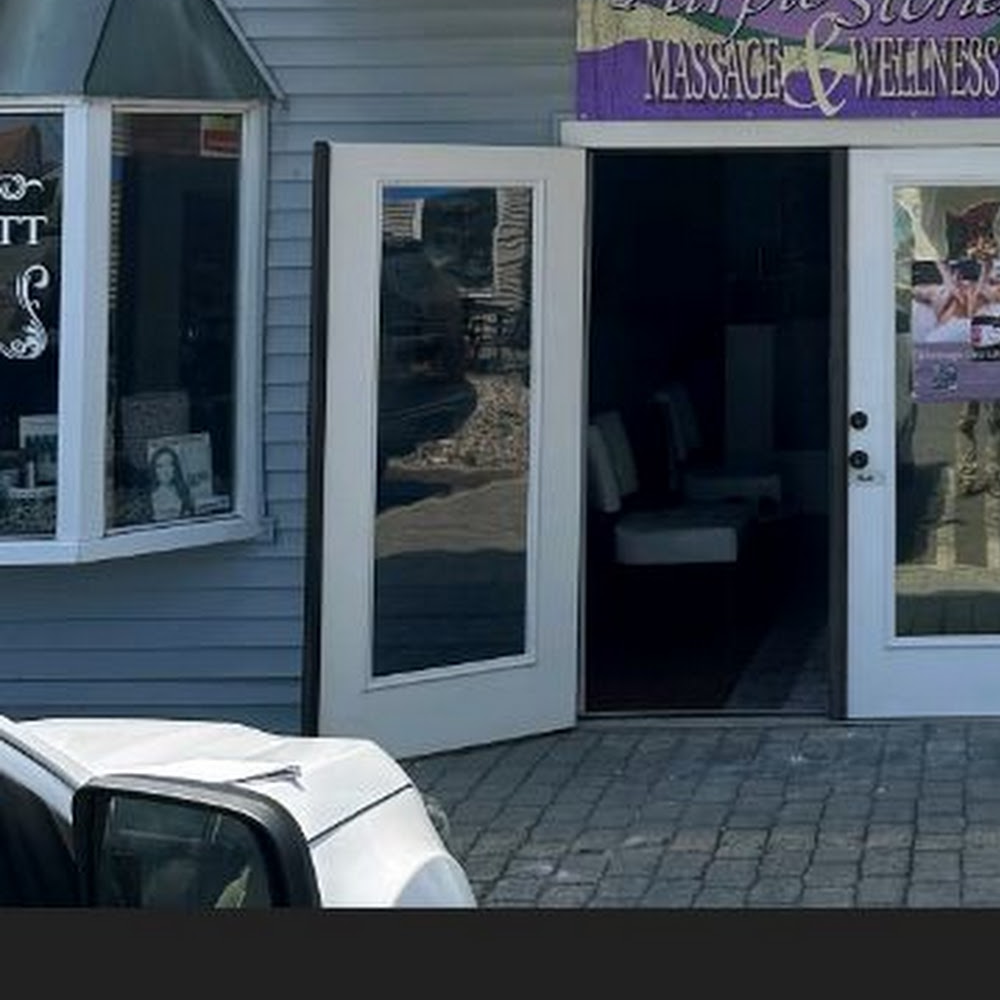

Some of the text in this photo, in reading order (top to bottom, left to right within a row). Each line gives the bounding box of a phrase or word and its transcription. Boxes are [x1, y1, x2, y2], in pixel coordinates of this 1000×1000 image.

[644, 13, 1000, 117] MASSAGE & WELLNESS
